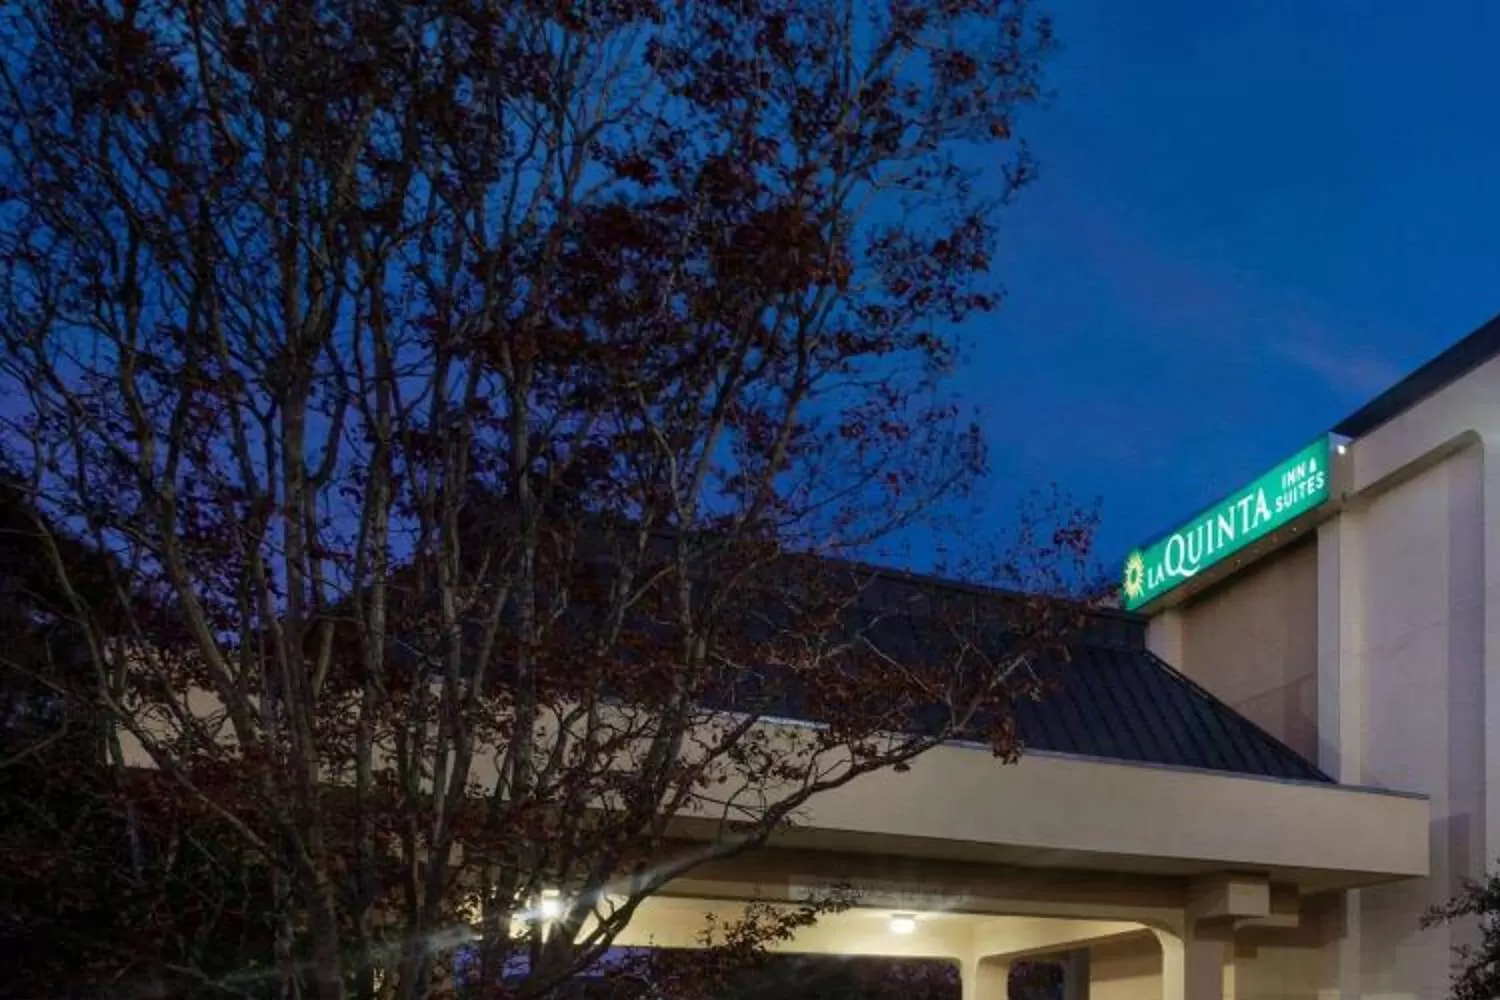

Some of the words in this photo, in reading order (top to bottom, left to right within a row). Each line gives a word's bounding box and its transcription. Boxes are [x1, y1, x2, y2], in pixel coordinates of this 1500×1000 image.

[1275, 470, 1325, 513] SUITES
[1281, 461, 1306, 489] INN
[1164, 487, 1272, 577] QUINTA
